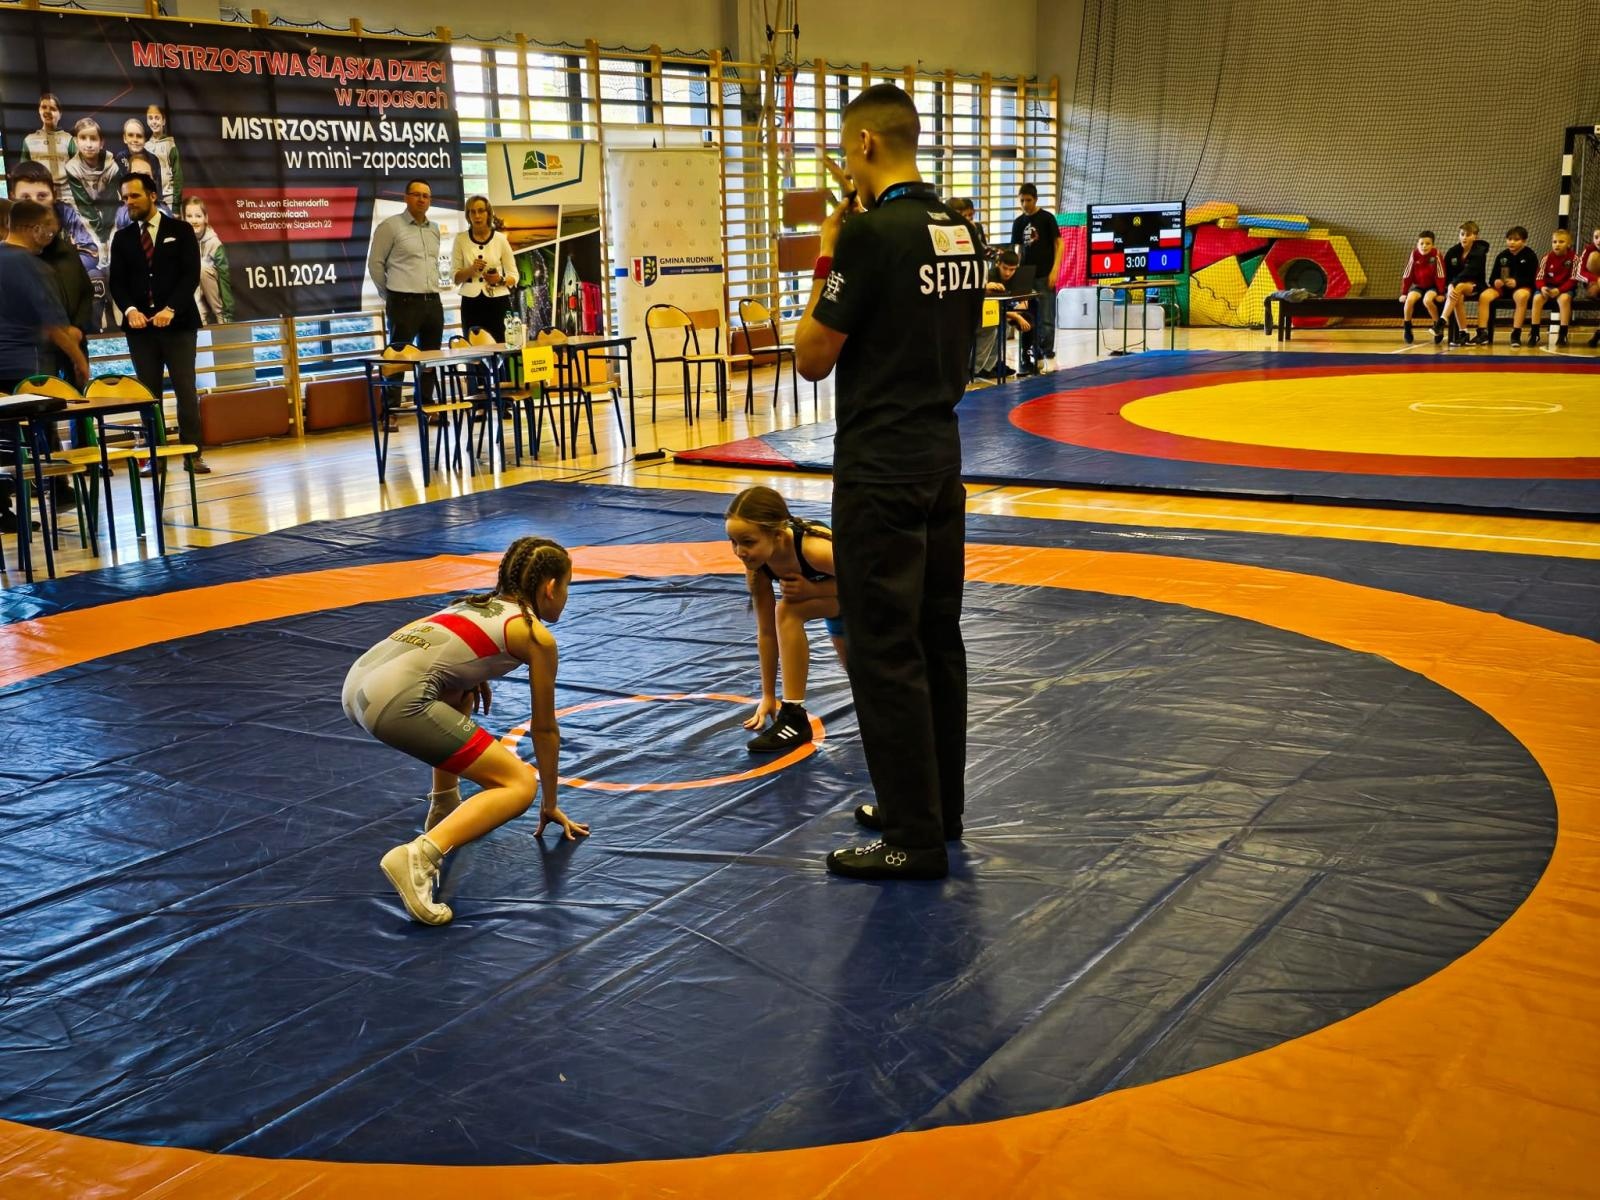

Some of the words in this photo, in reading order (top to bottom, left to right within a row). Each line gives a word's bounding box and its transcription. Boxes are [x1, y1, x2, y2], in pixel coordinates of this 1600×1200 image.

[132, 41, 306, 76] MISTRZOSTWA
[307, 47, 385, 85] ŚLĄSKA
[388, 59, 446, 83] DZIECI
[355, 86, 448, 115] zapasach
[221, 116, 378, 143] MISTRZOSTWA
[379, 114, 450, 148] ŚLĄSKA
[284, 151, 302, 169] w
[308, 146, 451, 176] mini-zapasach
[266, 200, 281, 208] von
[245, 209, 309, 221] Grzegorzowicach
[323, 219, 332, 228] 22
[1149, 235, 1159, 243] POL
[660, 257, 685, 265] GMINA
[686, 256, 714, 264] RUDNIK
[1103, 256, 1111, 269] 0
[1125, 255, 1146, 268] 3:00
[1161, 254, 1167, 266] 0
[245, 263, 337, 289] 16.11.2024
[1082, 302, 1089, 316] 1
